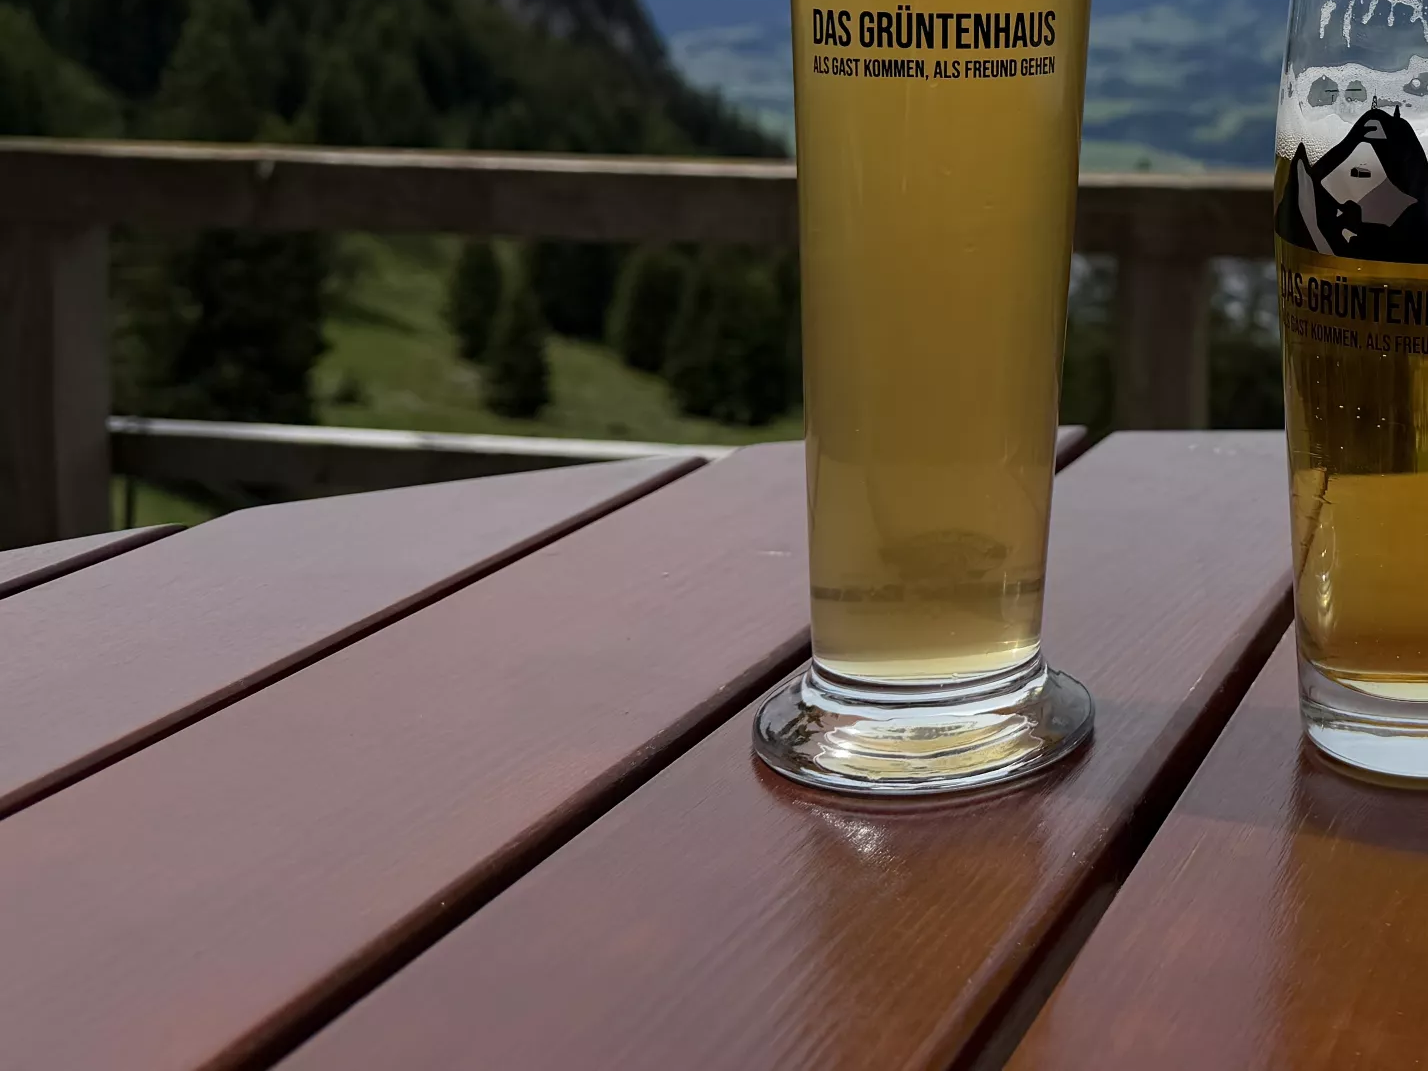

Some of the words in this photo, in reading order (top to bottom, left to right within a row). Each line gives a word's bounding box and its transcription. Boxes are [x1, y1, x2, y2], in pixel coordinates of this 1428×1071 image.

[813, 8, 851, 47] DAS
[859, 5, 1056, 49] GRÜNTENHAUS
[813, 55, 829, 74] ALS
[832, 56, 860, 76] GAST
[864, 59, 929, 80] KOMMEN,
[933, 60, 961, 79] ALS
[965, 59, 1016, 78] FREUND
[1020, 56, 1056, 76] GEHEN
[1281, 264, 1303, 307] DAS
[1291, 315, 1308, 337] GAST
[1366, 332, 1391, 352] ALS
